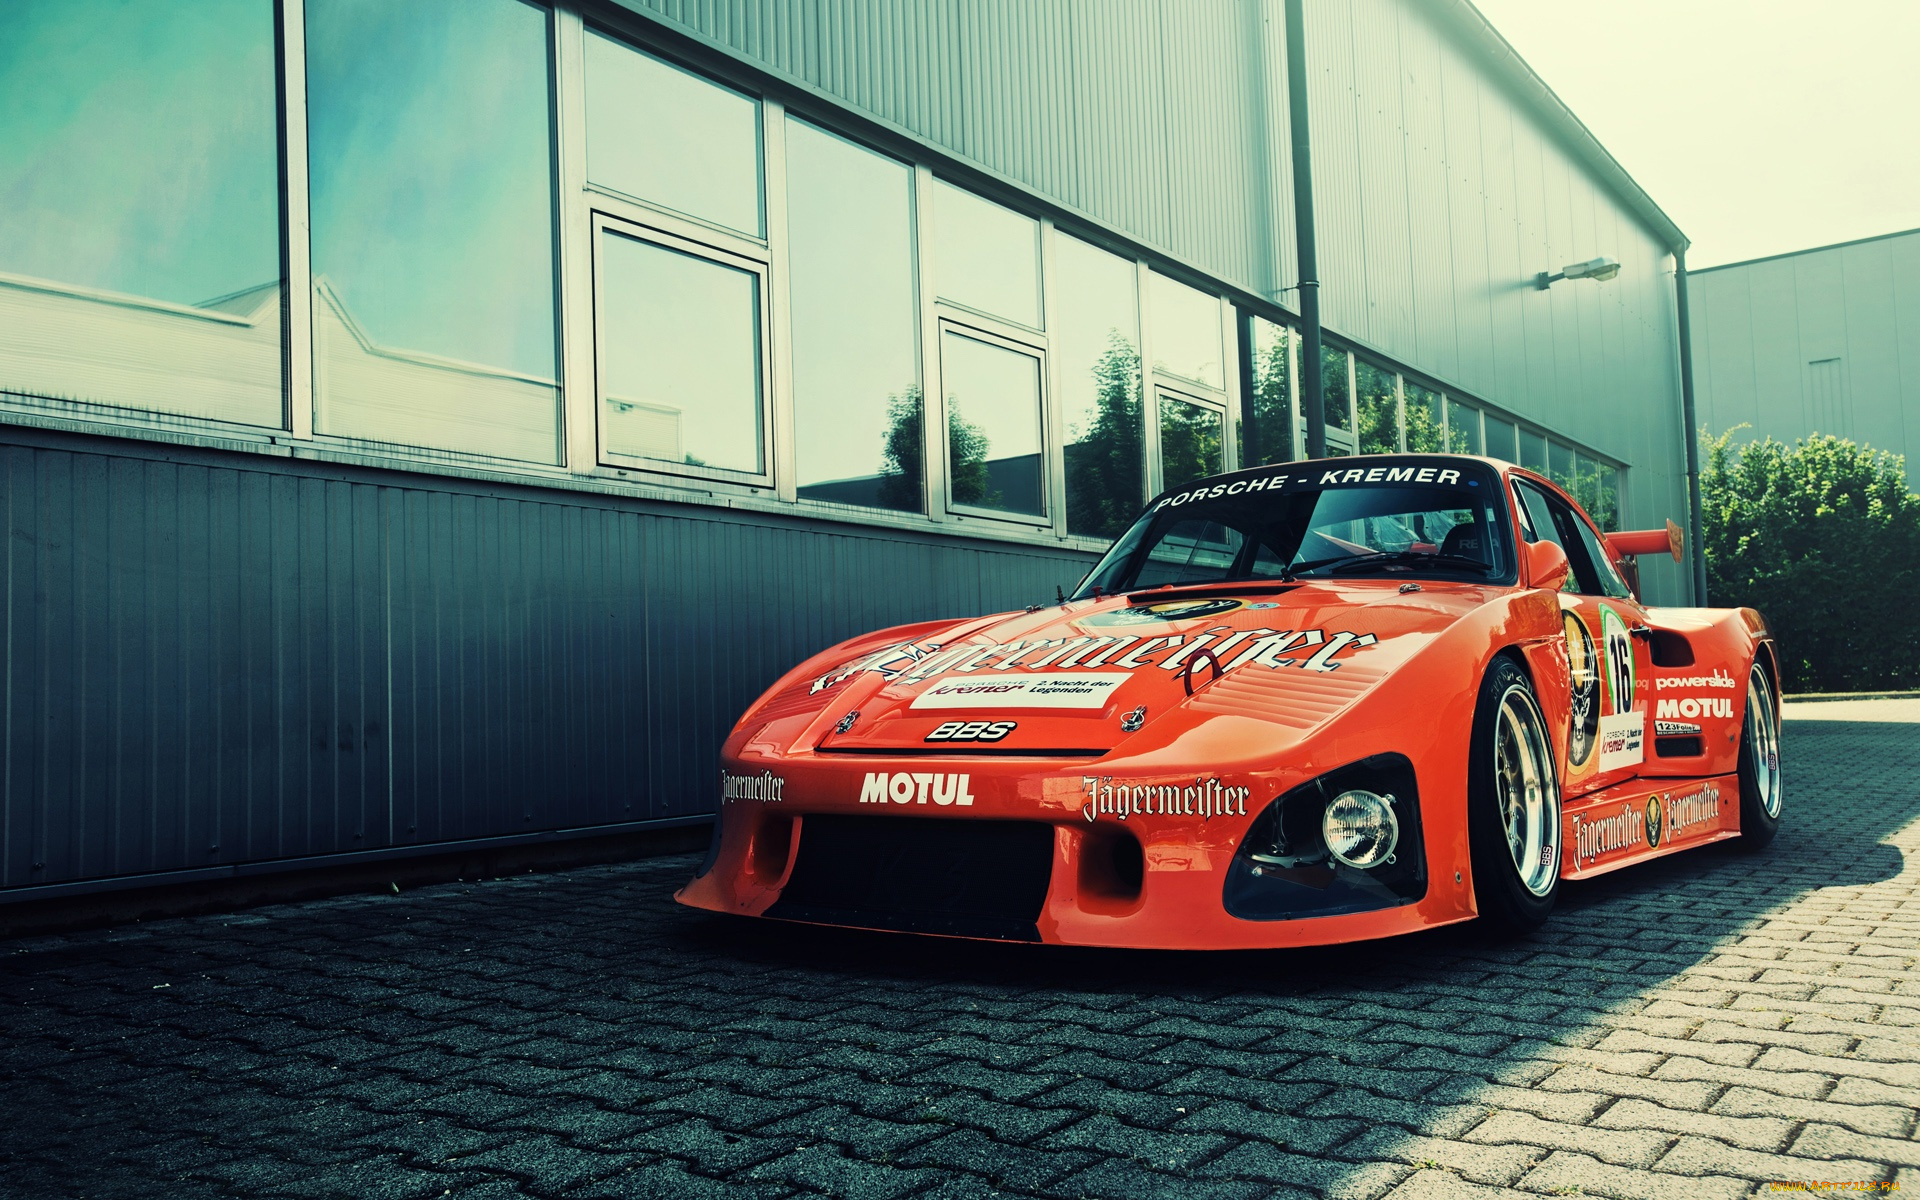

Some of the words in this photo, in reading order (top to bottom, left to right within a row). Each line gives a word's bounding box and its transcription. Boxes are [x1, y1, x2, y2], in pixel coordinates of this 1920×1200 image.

[1153, 475, 1290, 513] PORSCHE
[1319, 466, 1461, 486] KREMER
[1609, 633, 1632, 715] 16
[1655, 668, 1736, 691] powerslide
[928, 685, 1024, 696] kremer
[1656, 698, 1734, 719] MOTUL
[924, 720, 1017, 743] BBS
[859, 772, 975, 806] MOTUL
[1082, 775, 1251, 823] Jägermeister
[1573, 803, 1643, 873] Jägermeister
[1541, 846, 1553, 866] BBS
